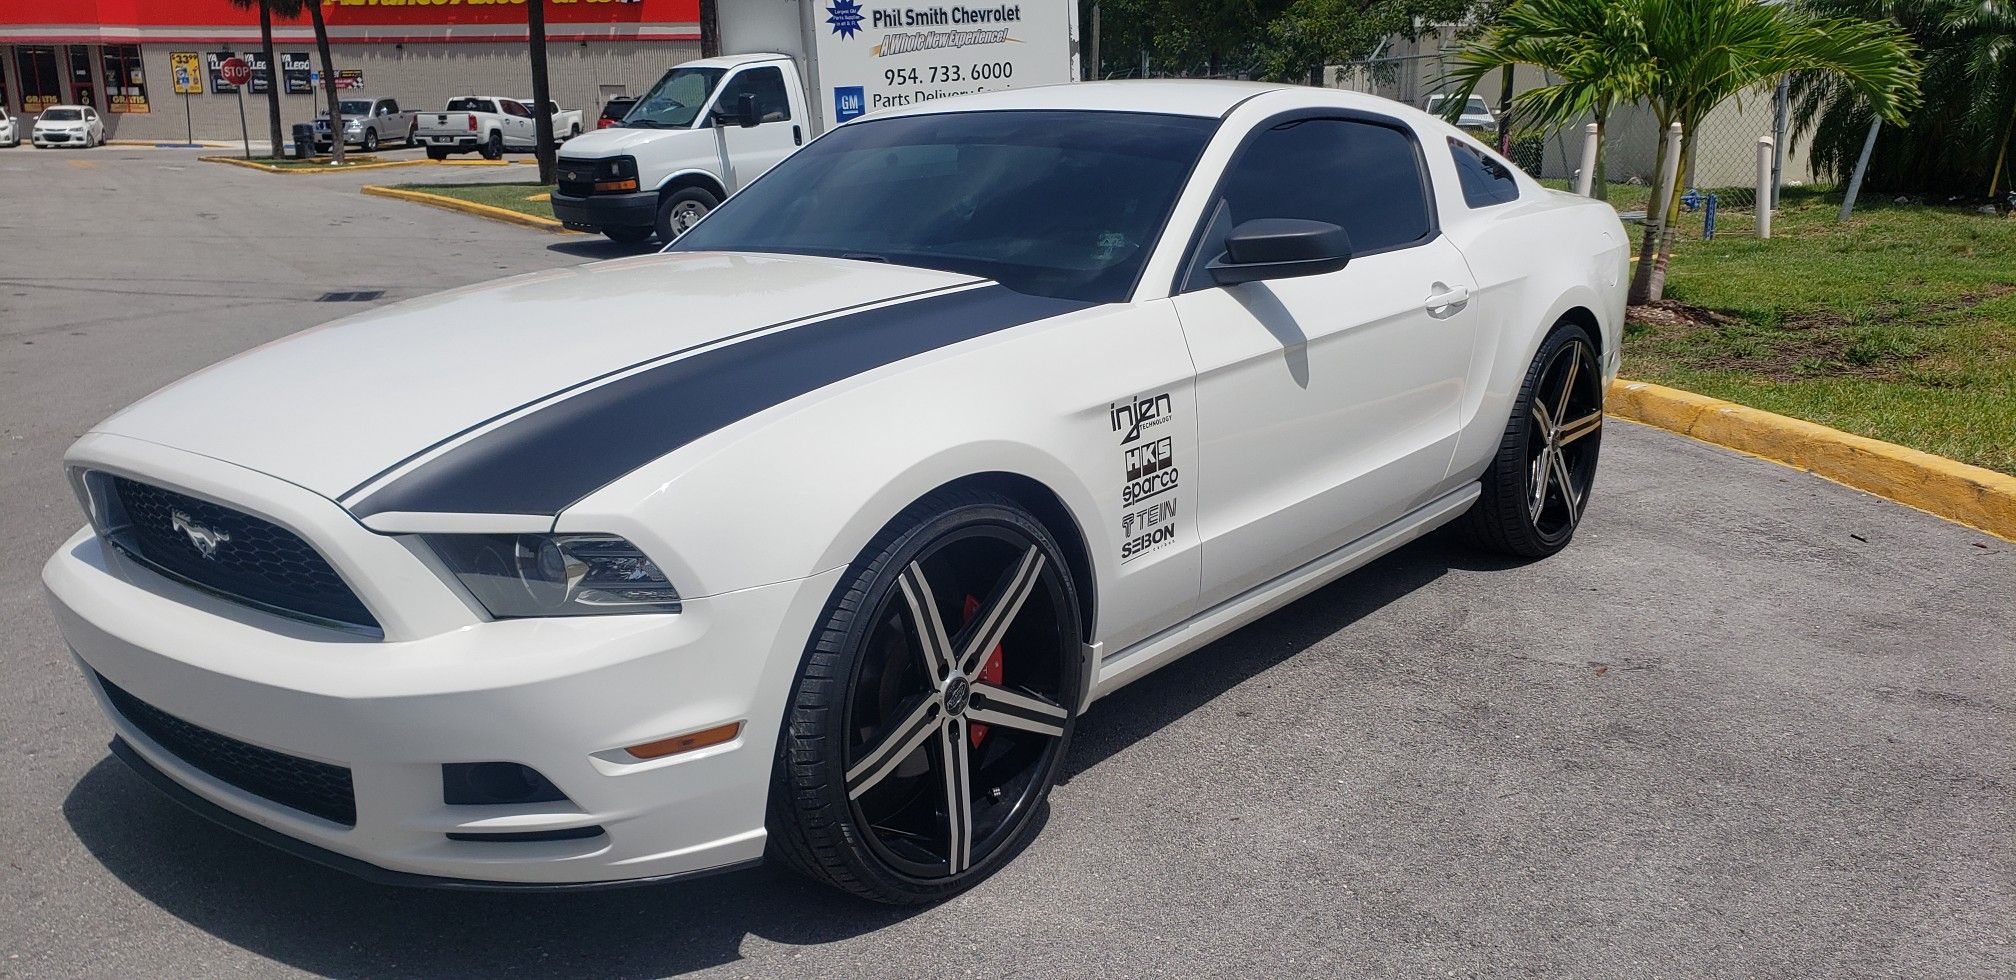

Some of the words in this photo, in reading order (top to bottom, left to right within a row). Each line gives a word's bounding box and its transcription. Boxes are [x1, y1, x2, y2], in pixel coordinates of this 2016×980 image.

[873, 10, 902, 28] Phil
[905, 8, 948, 26] Smith
[952, 5, 1020, 24] Chevrolet
[879, 35, 890, 57] A
[889, 32, 926, 55] Whole
[924, 31, 951, 50] New
[949, 28, 1008, 48] Experience!
[208, 54, 217, 62] YA
[245, 54, 254, 62] YA
[282, 54, 291, 62] YA
[224, 66, 250, 77] STOP
[884, 68, 923, 86] 954.
[928, 65, 966, 83] 733.
[970, 61, 1013, 80] 6000
[841, 95, 858, 110] GM
[873, 93, 910, 108] Parts
[1139, 415, 1172, 431] TECHNOLOGY
[1125, 437, 1172, 476] HKS
[1122, 467, 1179, 505] sparco
[1136, 498, 1177, 531] TEIN
[1121, 523, 1175, 559] SEBON
